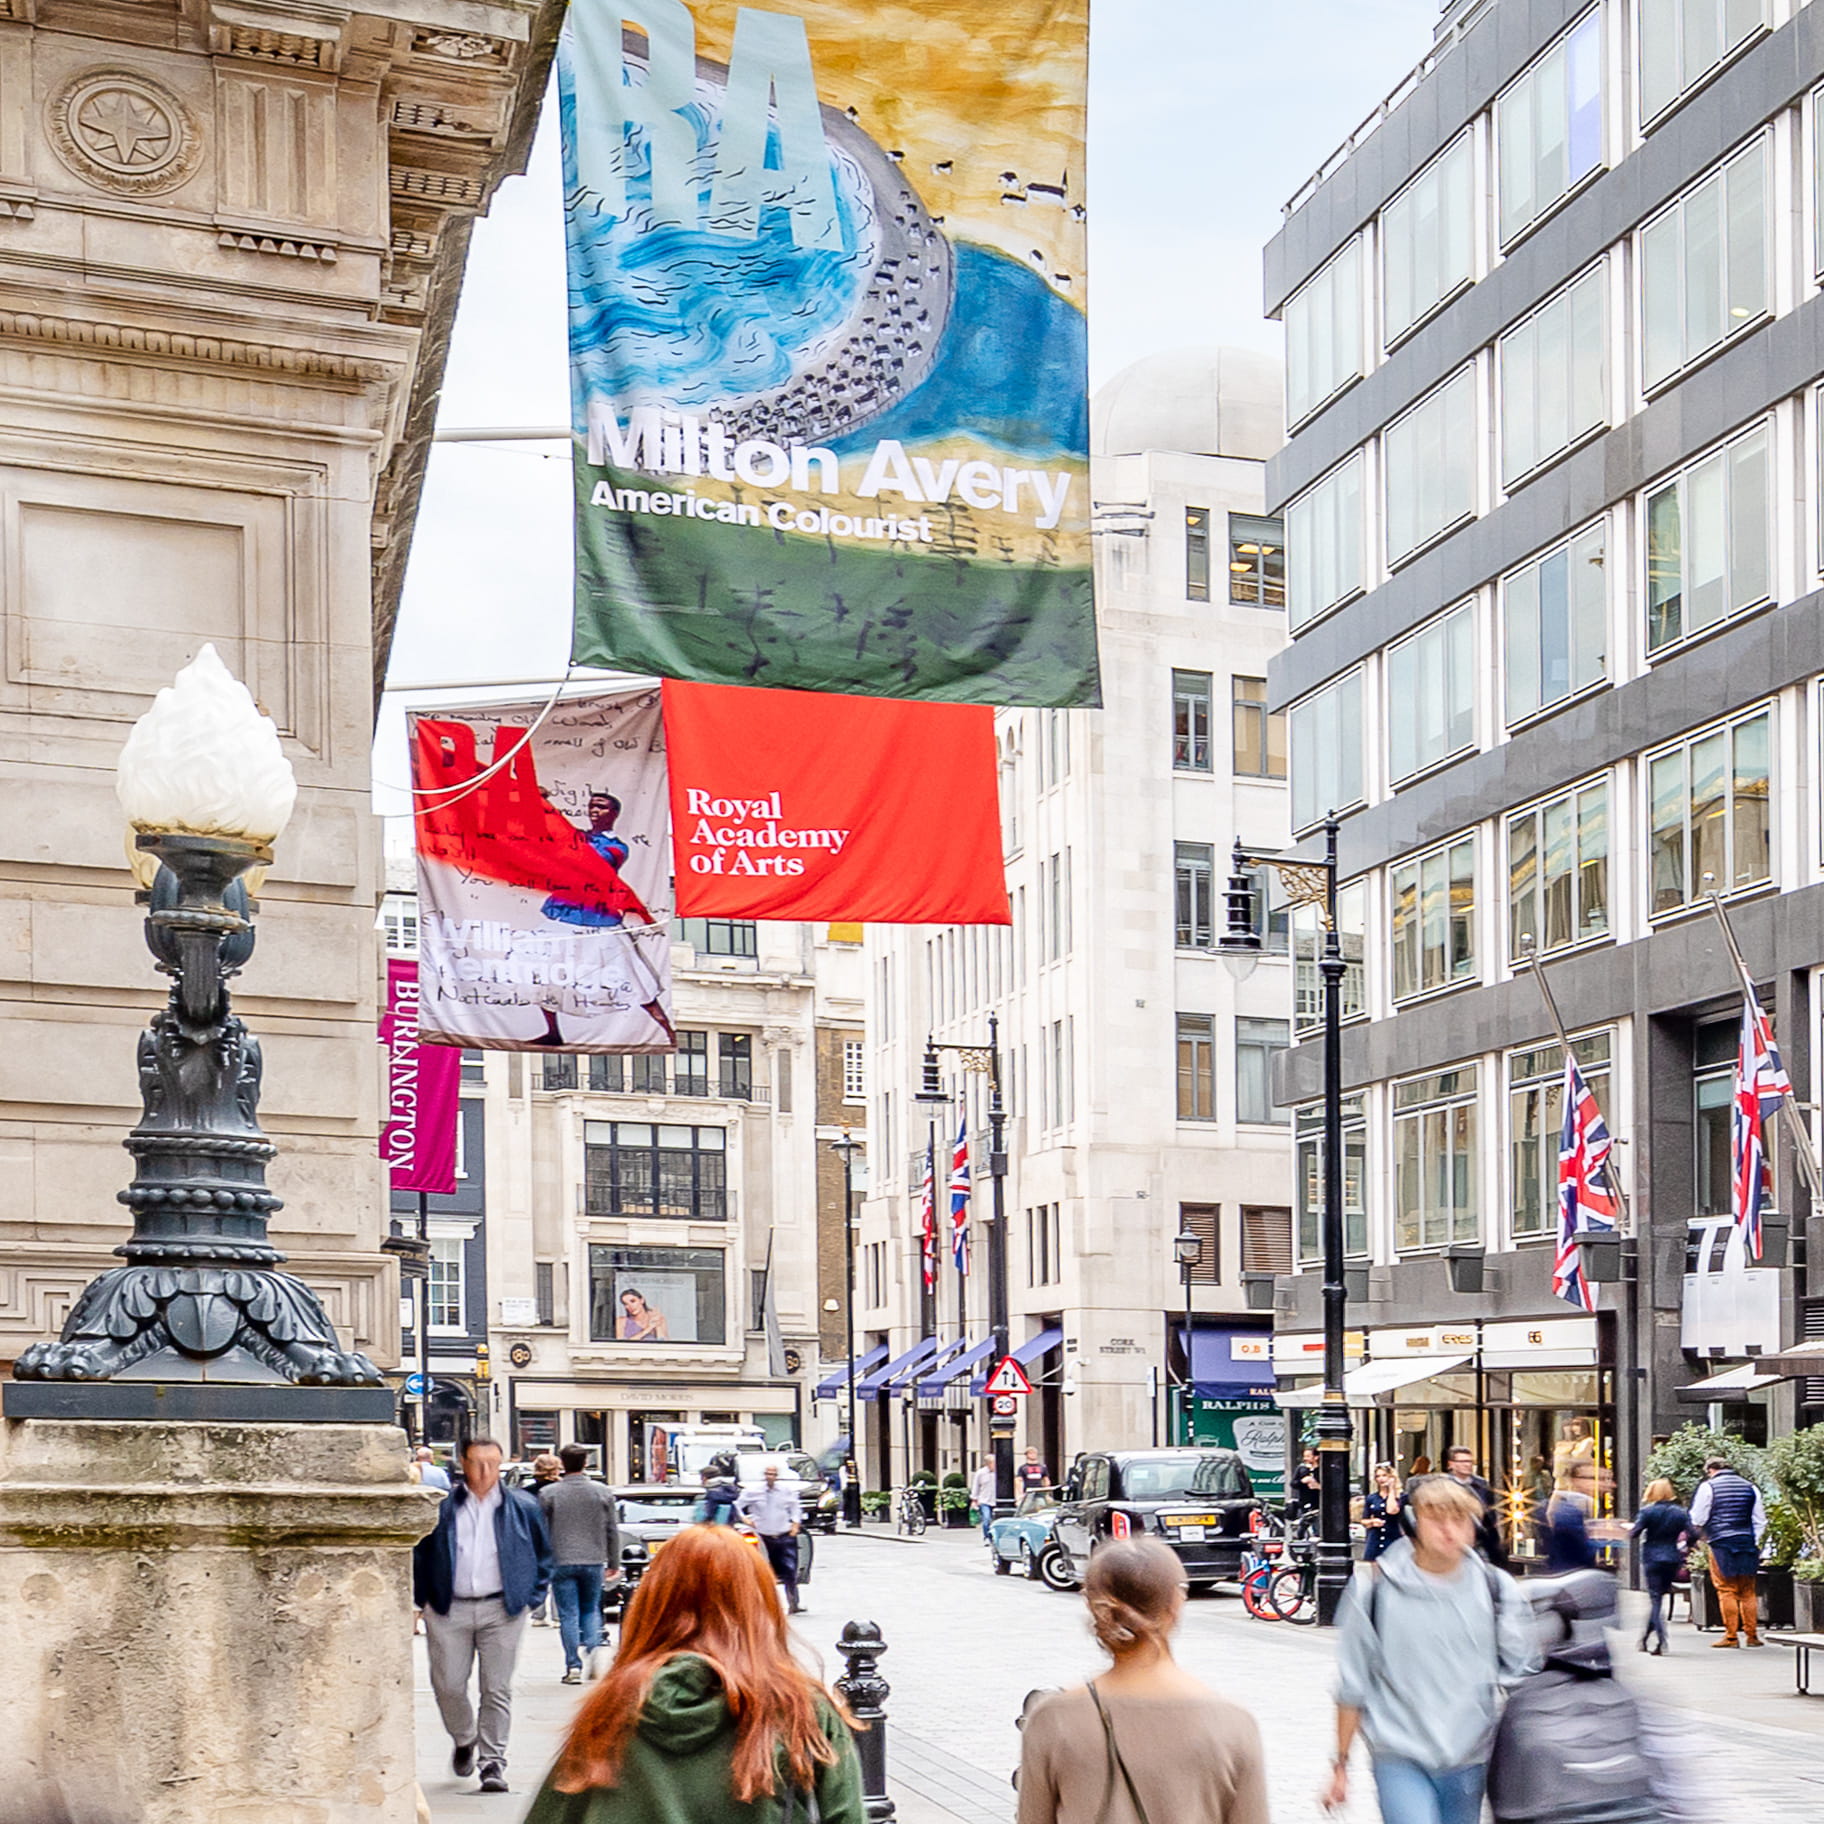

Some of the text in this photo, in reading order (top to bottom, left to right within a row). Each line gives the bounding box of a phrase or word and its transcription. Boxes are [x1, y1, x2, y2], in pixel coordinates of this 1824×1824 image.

[586, 402, 1072, 530] Milton Avery
[589, 480, 934, 544] American Colourist
[686, 788, 783, 825] Royal
[689, 818, 850, 855] Academy
[689, 847, 805, 877] of Arts
[388, 980, 421, 1171] BURLINGTON
[997, 1399, 1012, 1410] 20
